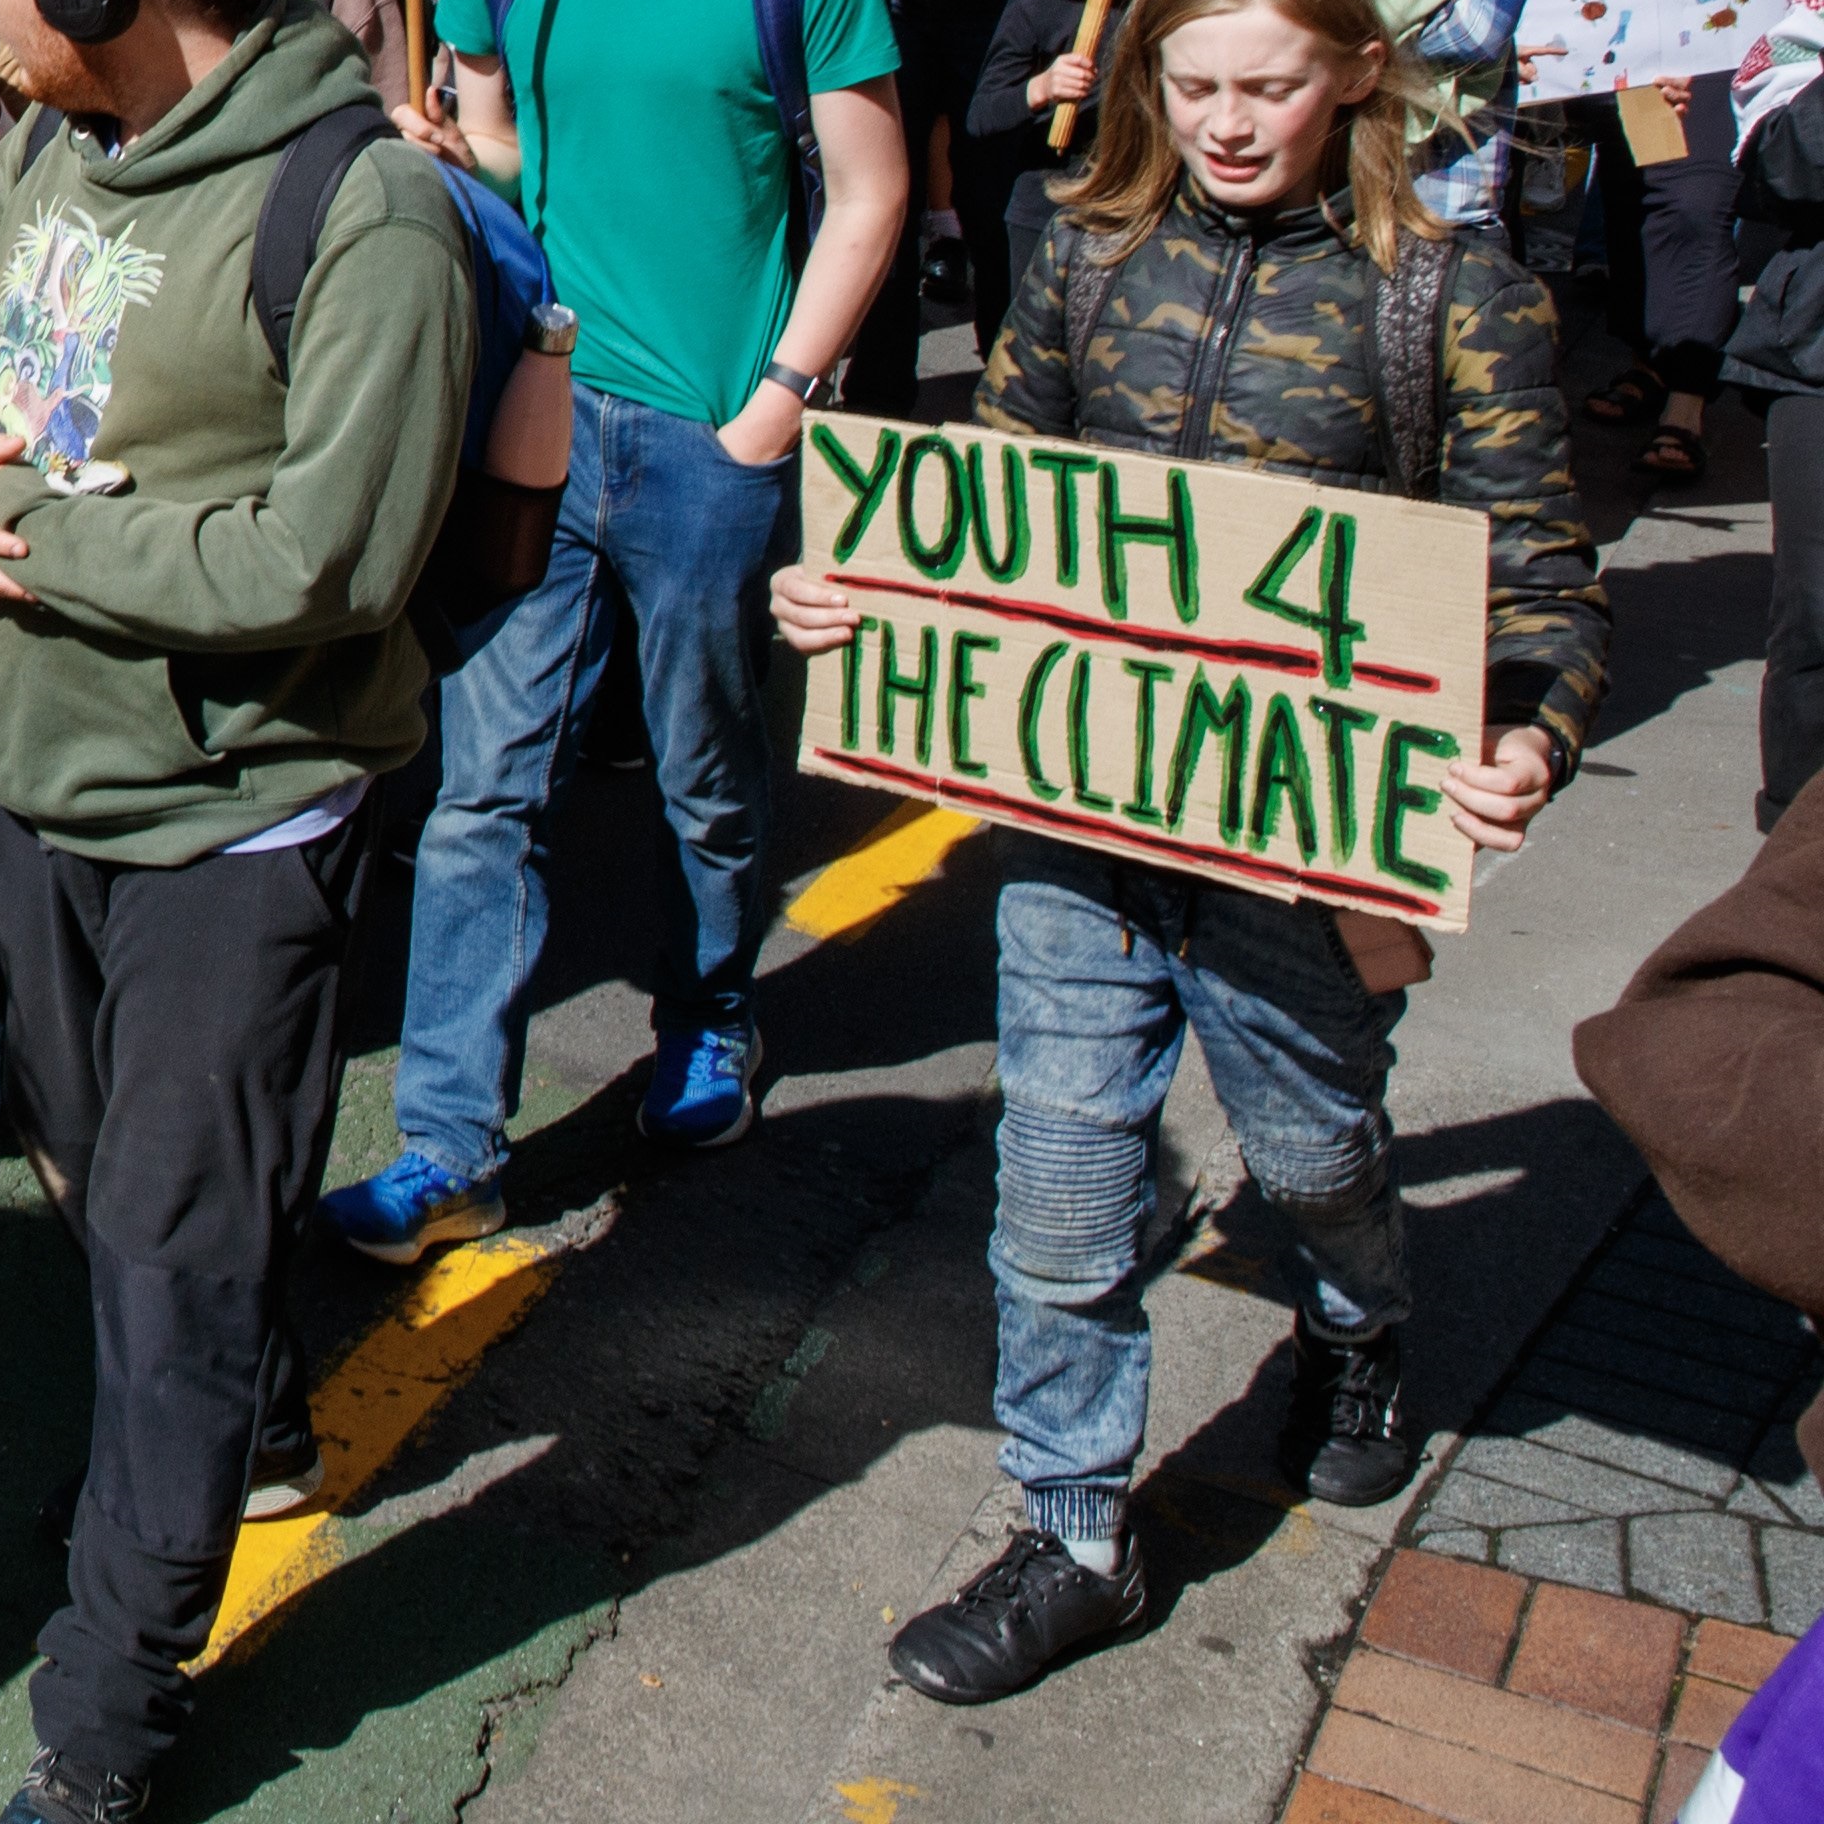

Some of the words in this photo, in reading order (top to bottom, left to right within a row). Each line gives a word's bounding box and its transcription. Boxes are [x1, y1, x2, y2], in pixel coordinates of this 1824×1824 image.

[810, 421, 1201, 623] YOUTH
[1244, 506, 1367, 689] 4
[840, 616, 1003, 778] THE
[1018, 641, 1462, 892] CLIMATE
